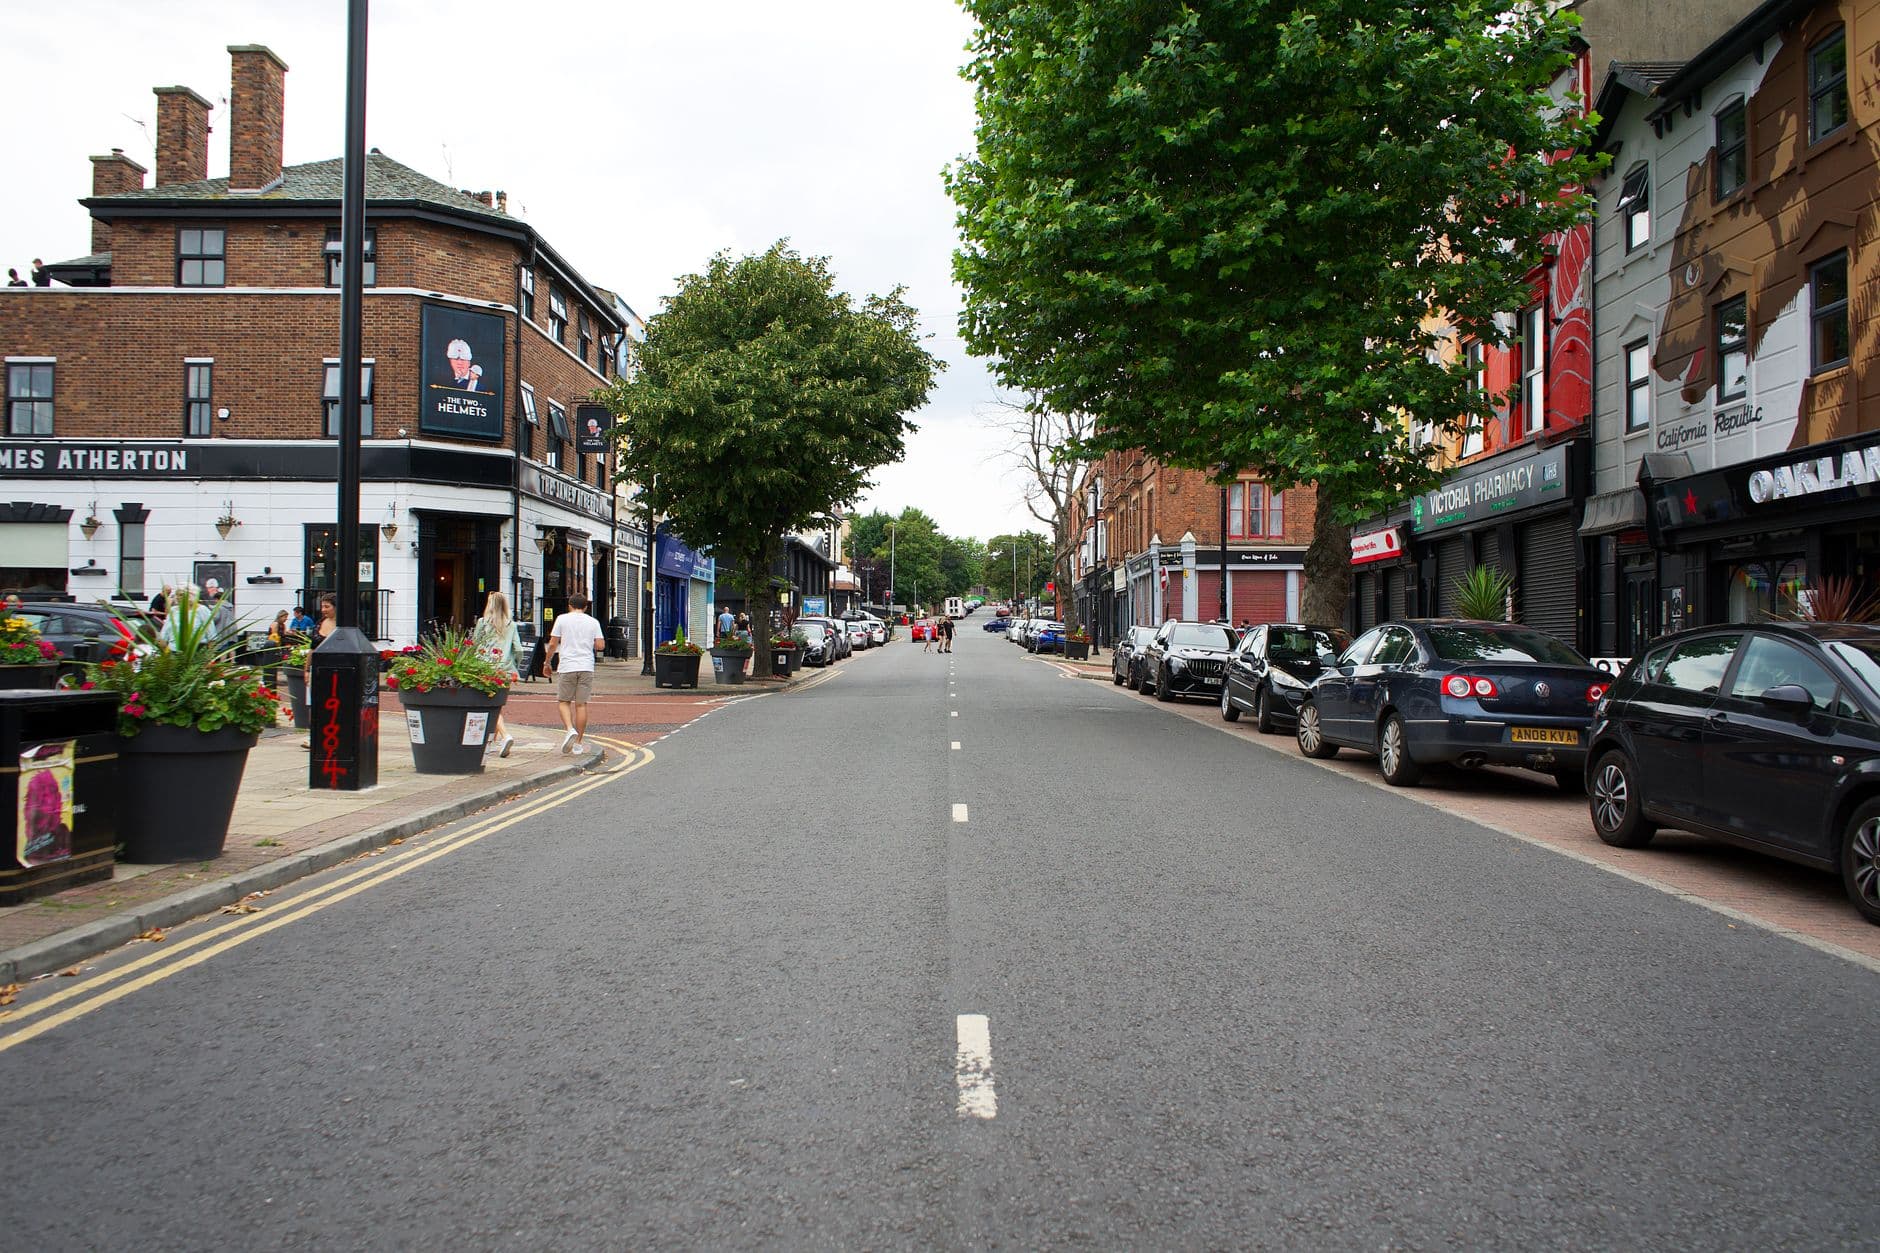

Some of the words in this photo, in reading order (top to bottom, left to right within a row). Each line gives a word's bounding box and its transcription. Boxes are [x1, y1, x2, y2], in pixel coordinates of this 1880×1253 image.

[437, 402, 488, 418] HELMETS
[446, 396, 461, 405] THE
[462, 398, 479, 407] TWO
[1656, 422, 1708, 451] California
[1713, 406, 1763, 436] Republic
[56, 449, 187, 471] ATHERTON
[1429, 486, 1471, 516] VICTORIA
[1474, 463, 1534, 504] PHARMACY
[322, 672, 347, 790] 1984
[1517, 729, 1546, 741] AN08
[1550, 731, 1573, 742] KVA
